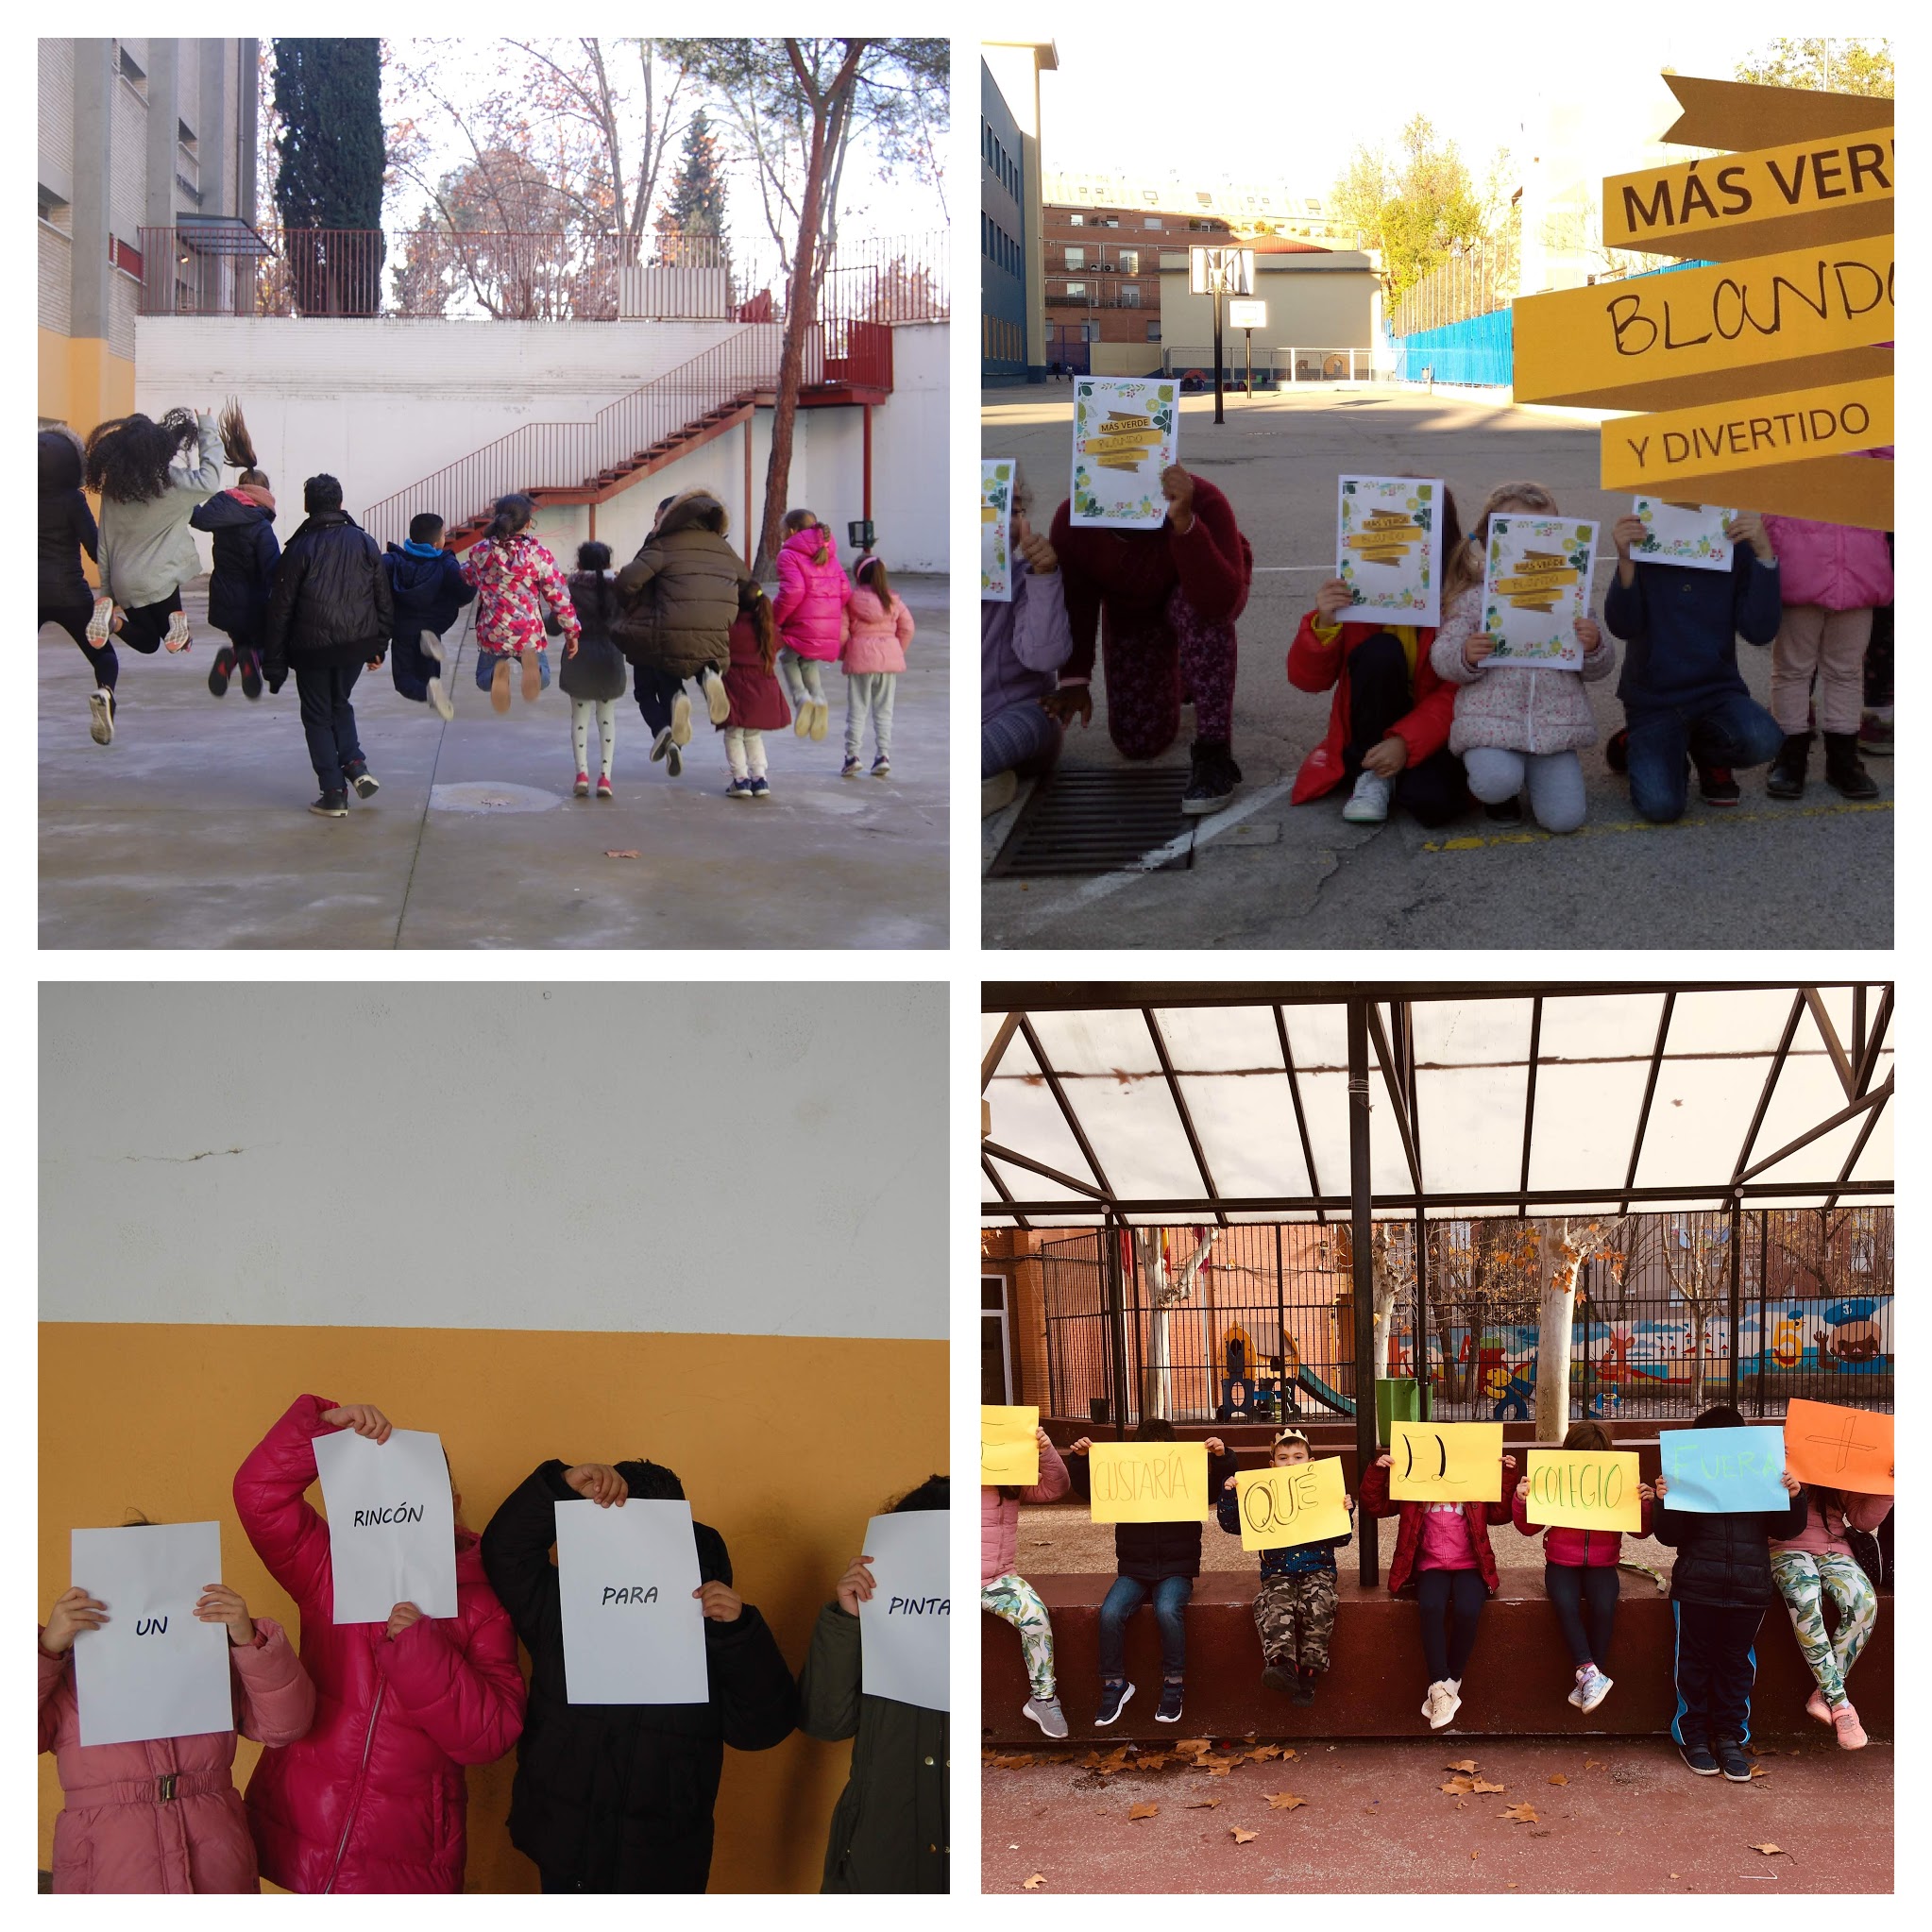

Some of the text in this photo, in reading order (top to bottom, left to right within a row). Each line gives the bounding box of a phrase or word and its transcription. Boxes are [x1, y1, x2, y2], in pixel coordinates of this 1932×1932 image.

[1101, 419, 1148, 432] MÁS VERDE
[1094, 1450, 1188, 1501] GUSTARÍA
[1672, 1444, 1779, 1483] FUERA
[1245, 1466, 1317, 1533] QUÉ
[1533, 1464, 1623, 1509] COLEGIO
[353, 1501, 425, 1528] RINCÓN
[602, 1585, 659, 1605] PARA
[135, 1616, 168, 1636] UN
